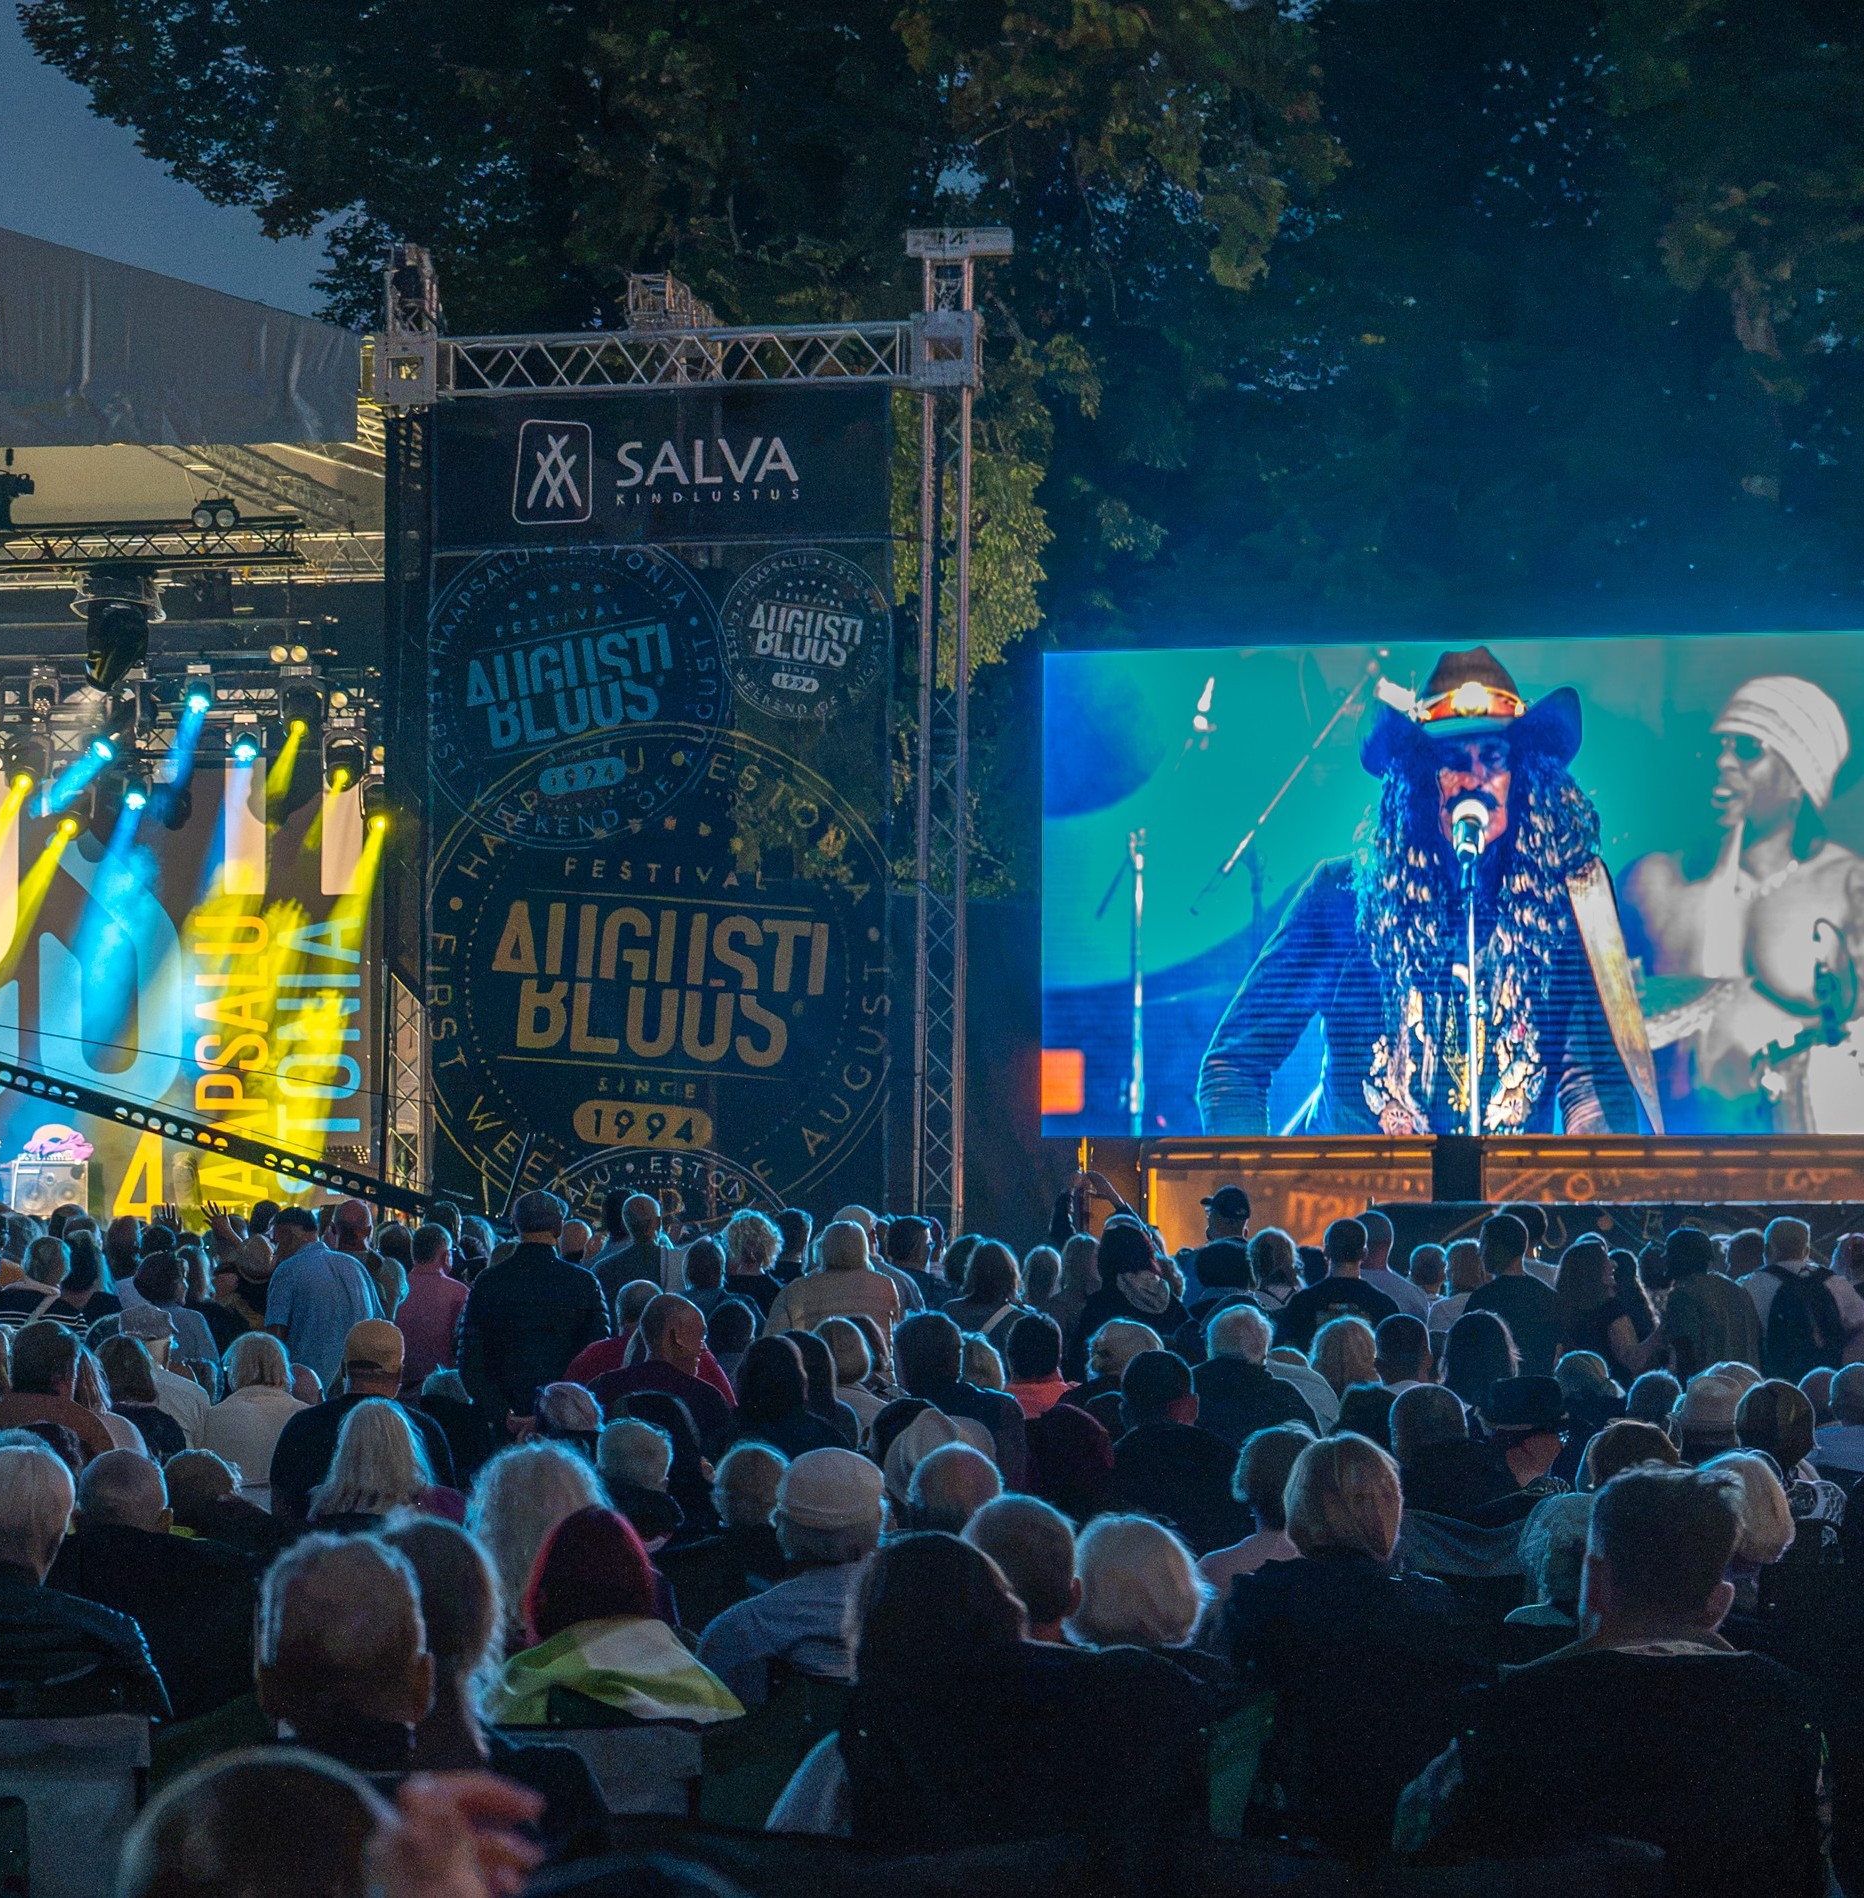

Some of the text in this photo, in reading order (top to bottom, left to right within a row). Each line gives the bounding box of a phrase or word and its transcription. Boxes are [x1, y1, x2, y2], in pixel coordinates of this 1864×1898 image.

[615, 436, 800, 487] SALVA
[615, 488, 800, 507] KINDLUSTUS
[495, 601, 623, 638] FESTIVAL
[749, 602, 864, 646] AUGUSTI
[466, 622, 674, 707] AUGUSTI
[564, 856, 768, 891] FESTIVAL
[491, 899, 830, 997] AUGUSTI
[194, 914, 269, 1200] APSALU
[276, 916, 362, 1195] TONIA
[426, 931, 469, 1071] FIRST
[800, 961, 892, 1157] AUGUST
[598, 1076, 698, 1099] SINCE
[589, 1106, 697, 1145] 1994
